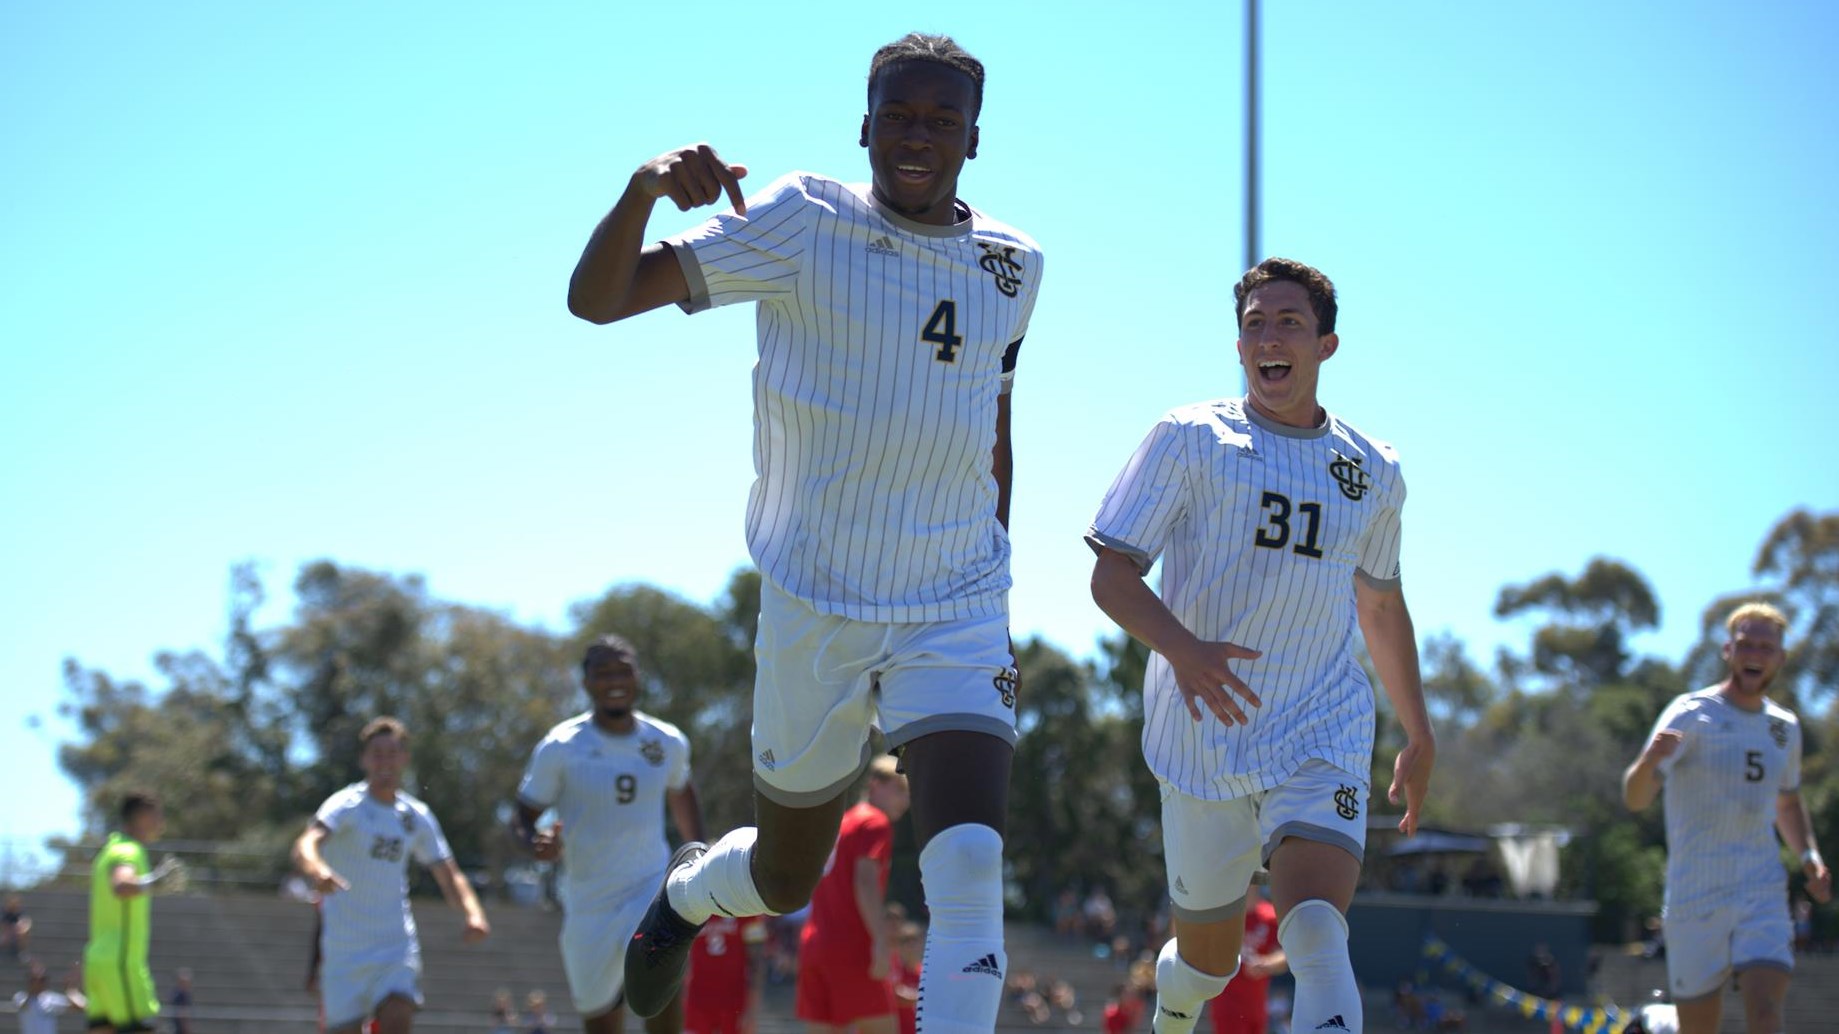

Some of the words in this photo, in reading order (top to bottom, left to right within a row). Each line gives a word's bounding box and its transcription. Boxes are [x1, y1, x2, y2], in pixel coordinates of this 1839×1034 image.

[865, 247, 899, 258] adidas
[920, 299, 963, 363] 4
[1253, 489, 1324, 560] 31
[1744, 749, 1765, 783] 5
[614, 773, 637, 806] 9
[962, 966, 1003, 980] adidas
